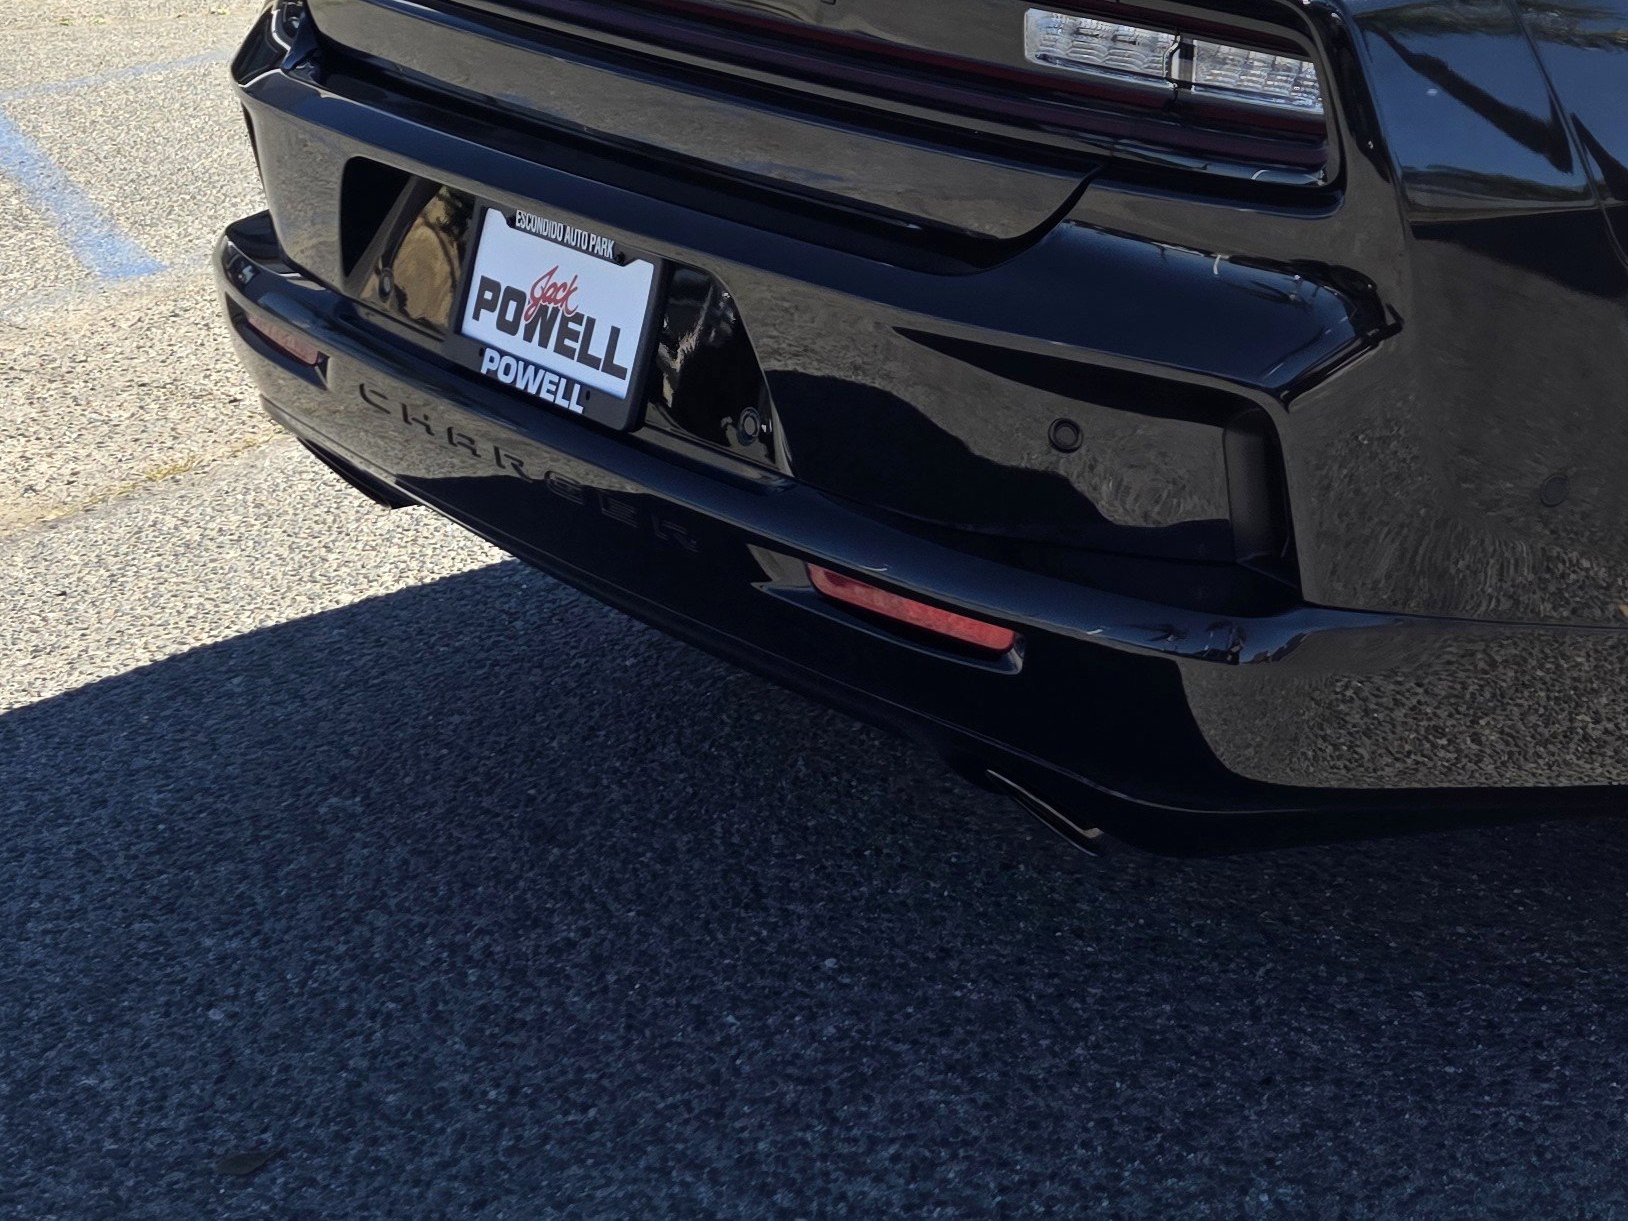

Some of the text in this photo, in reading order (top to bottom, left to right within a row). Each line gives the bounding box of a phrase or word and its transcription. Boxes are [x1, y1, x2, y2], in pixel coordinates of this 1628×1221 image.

[515, 209, 615, 259] ESCONDIDO AUTO PARK
[523, 265, 579, 322] Jack
[472, 275, 628, 380] POWELL
[480, 347, 584, 414] POWELL
